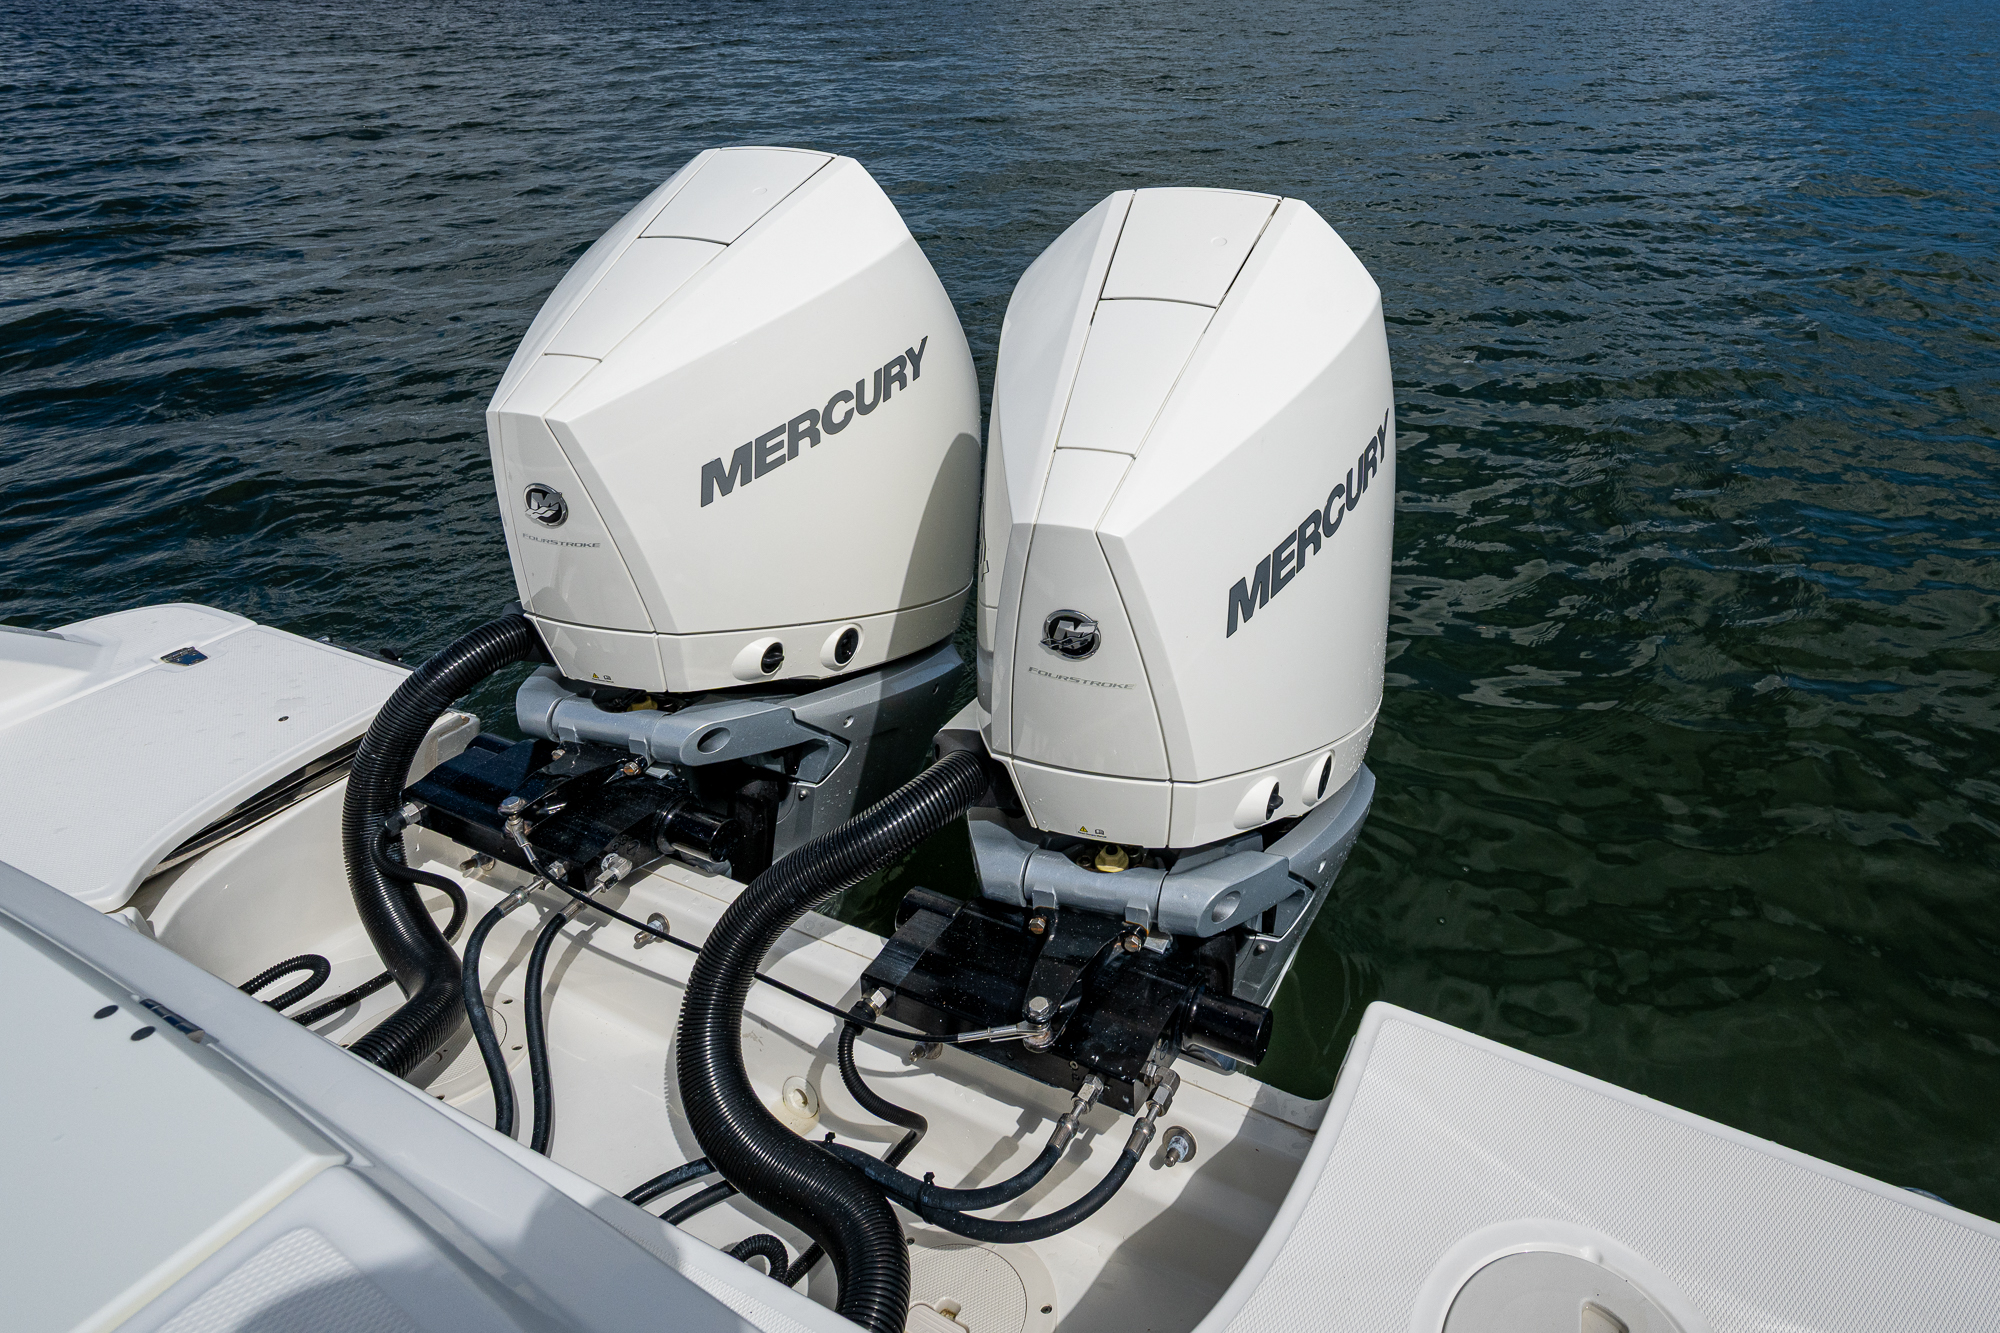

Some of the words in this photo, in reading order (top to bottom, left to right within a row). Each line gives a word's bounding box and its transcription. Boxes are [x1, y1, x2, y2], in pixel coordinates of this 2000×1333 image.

[700, 335, 929, 508] MERCURY
[522, 532, 601, 548] FOURSTROKE
[1226, 407, 1390, 639] MERCURY
[1028, 666, 1135, 690] FOURSTROKE
